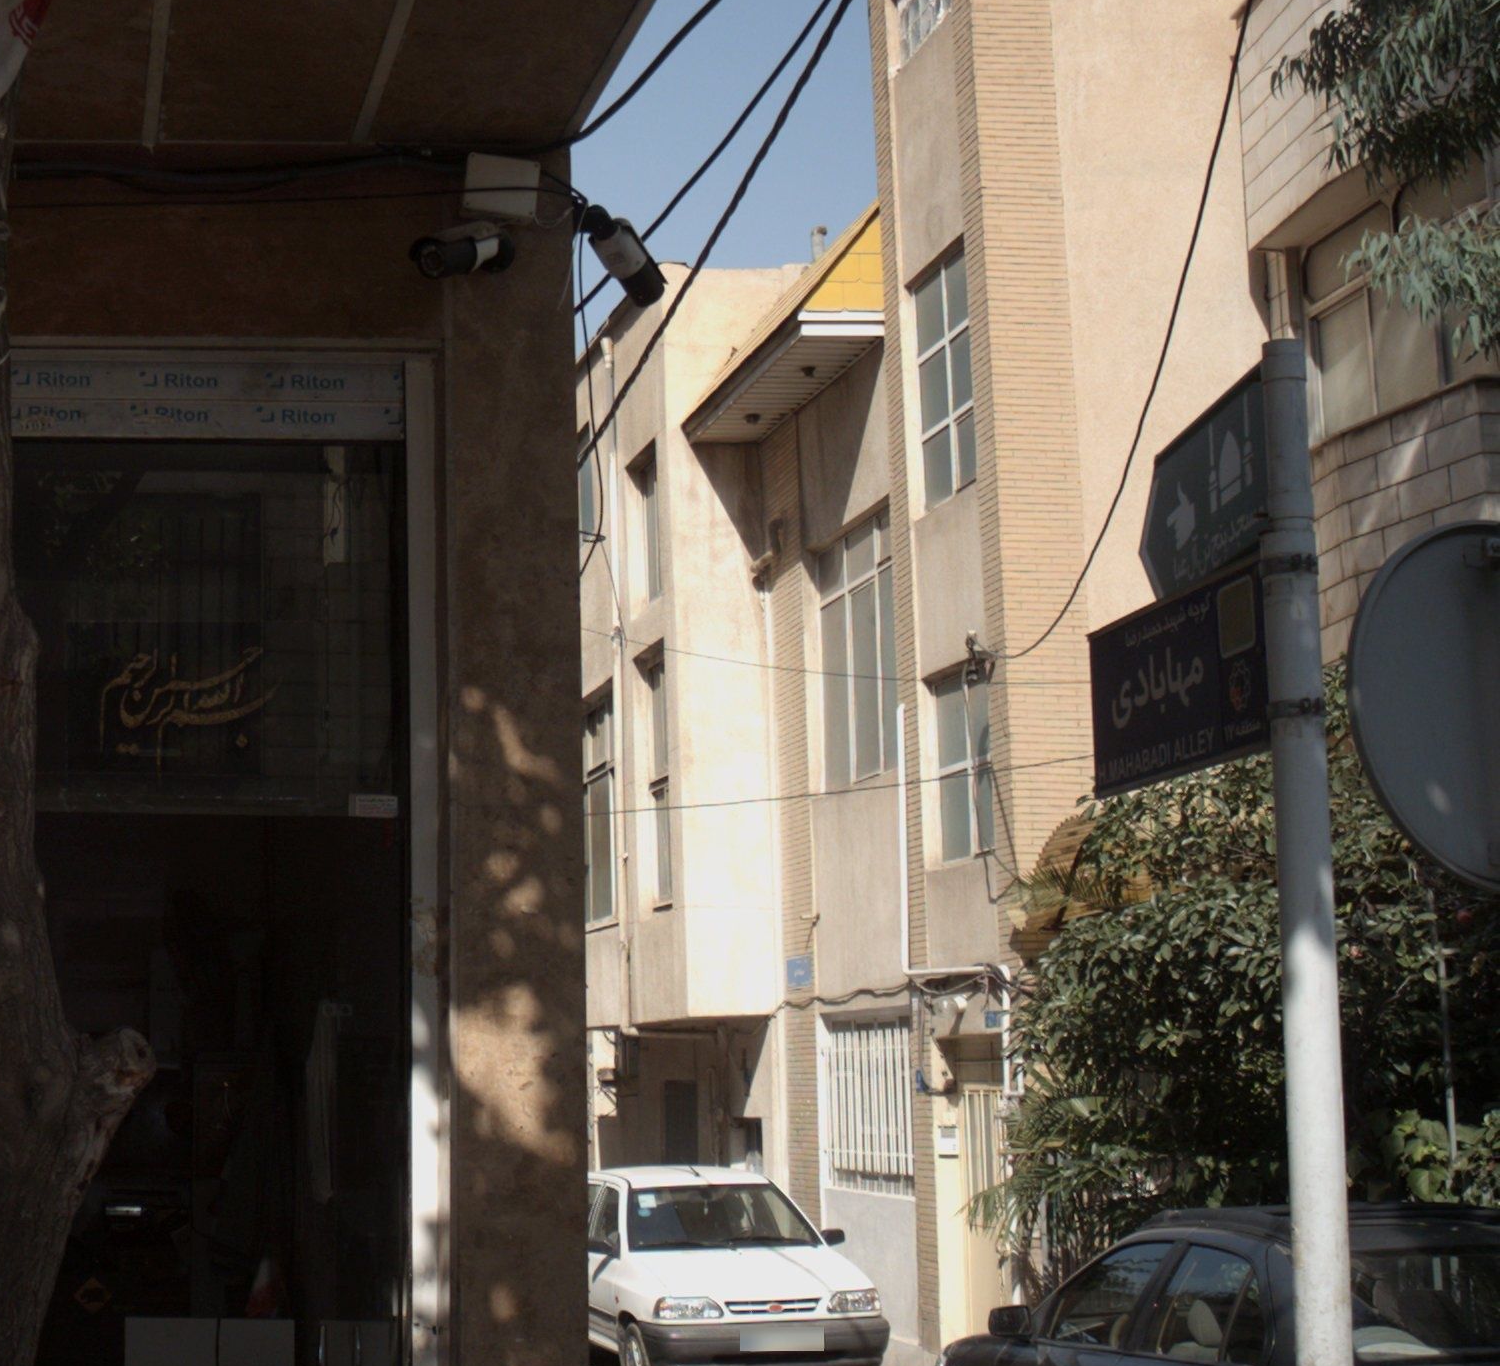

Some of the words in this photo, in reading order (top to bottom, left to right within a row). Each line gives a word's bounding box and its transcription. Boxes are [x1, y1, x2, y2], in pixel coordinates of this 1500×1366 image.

[37, 371, 90, 387] Riton
[165, 373, 218, 388] Riton
[291, 374, 345, 390] Riton
[281, 409, 335, 423] Riton
[1111, 646, 1204, 730] مهابادی
[1173, 726, 1215, 762] ALLEY
